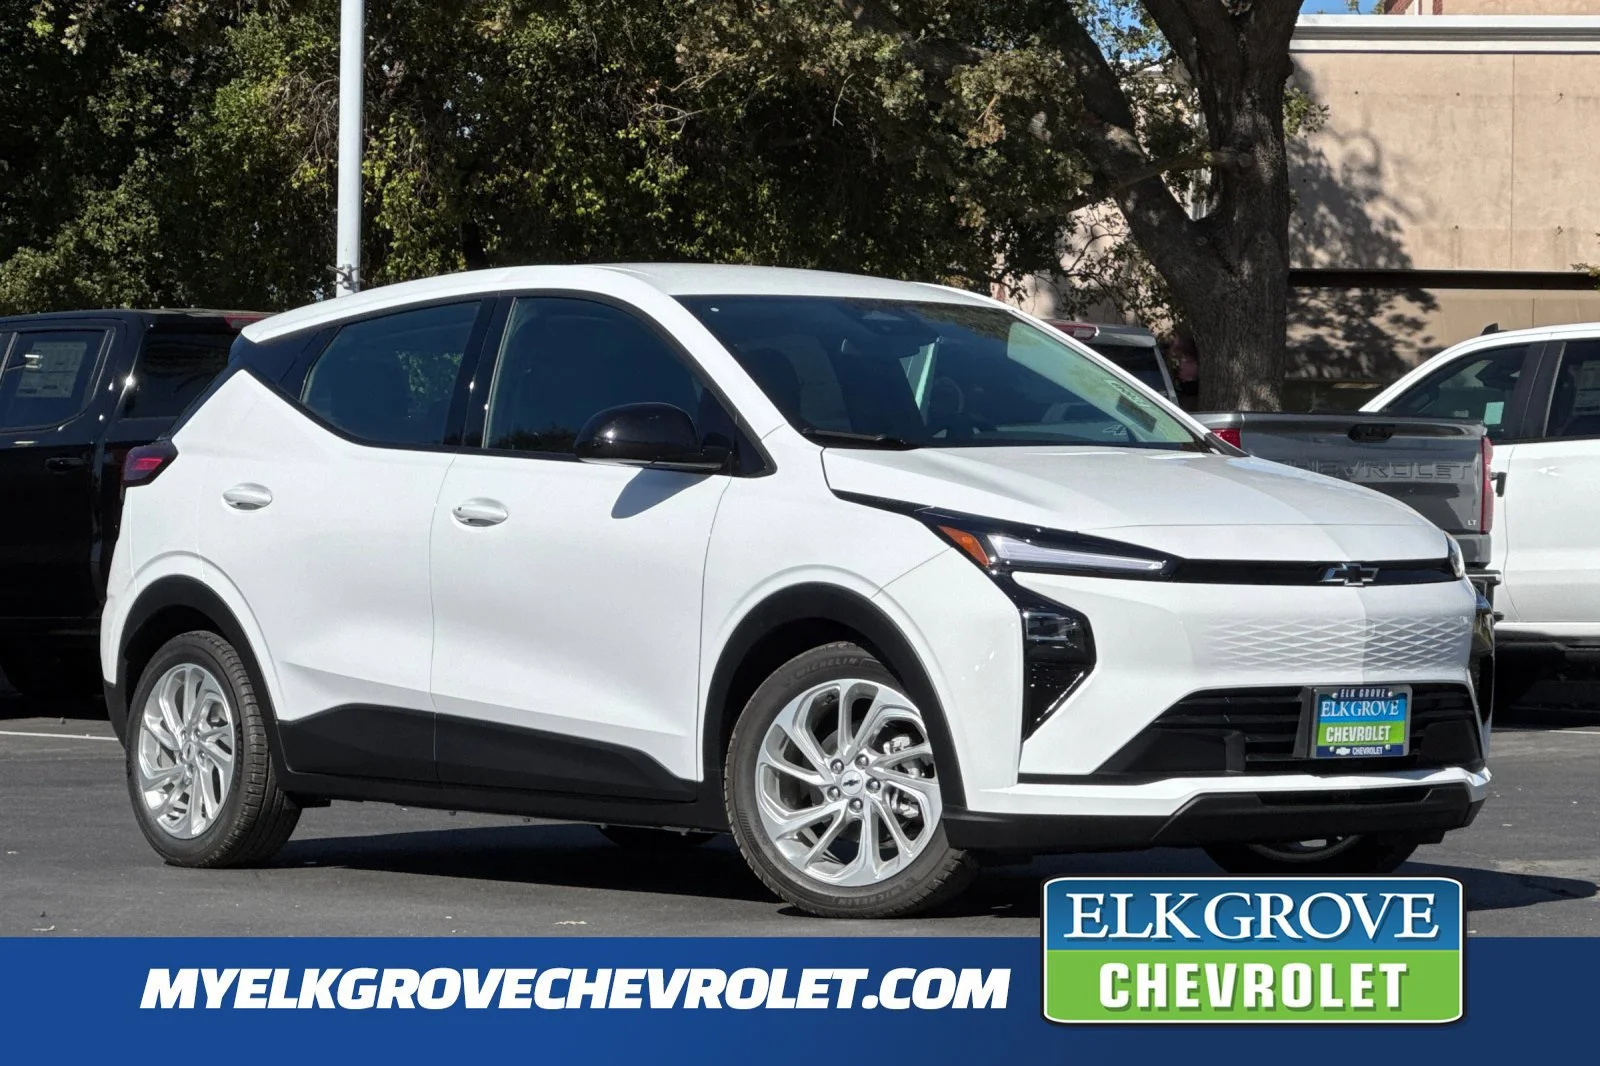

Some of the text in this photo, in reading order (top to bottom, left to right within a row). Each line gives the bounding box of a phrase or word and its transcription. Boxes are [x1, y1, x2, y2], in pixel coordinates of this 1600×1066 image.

[795, 657, 858, 677] MICHELIN
[1340, 688, 1386, 698] ELK GROVE
[1321, 700, 1399, 717] ELK GROVE
[1326, 726, 1391, 742] CHEVROLET
[1352, 746, 1383, 755] CHEVROLET
